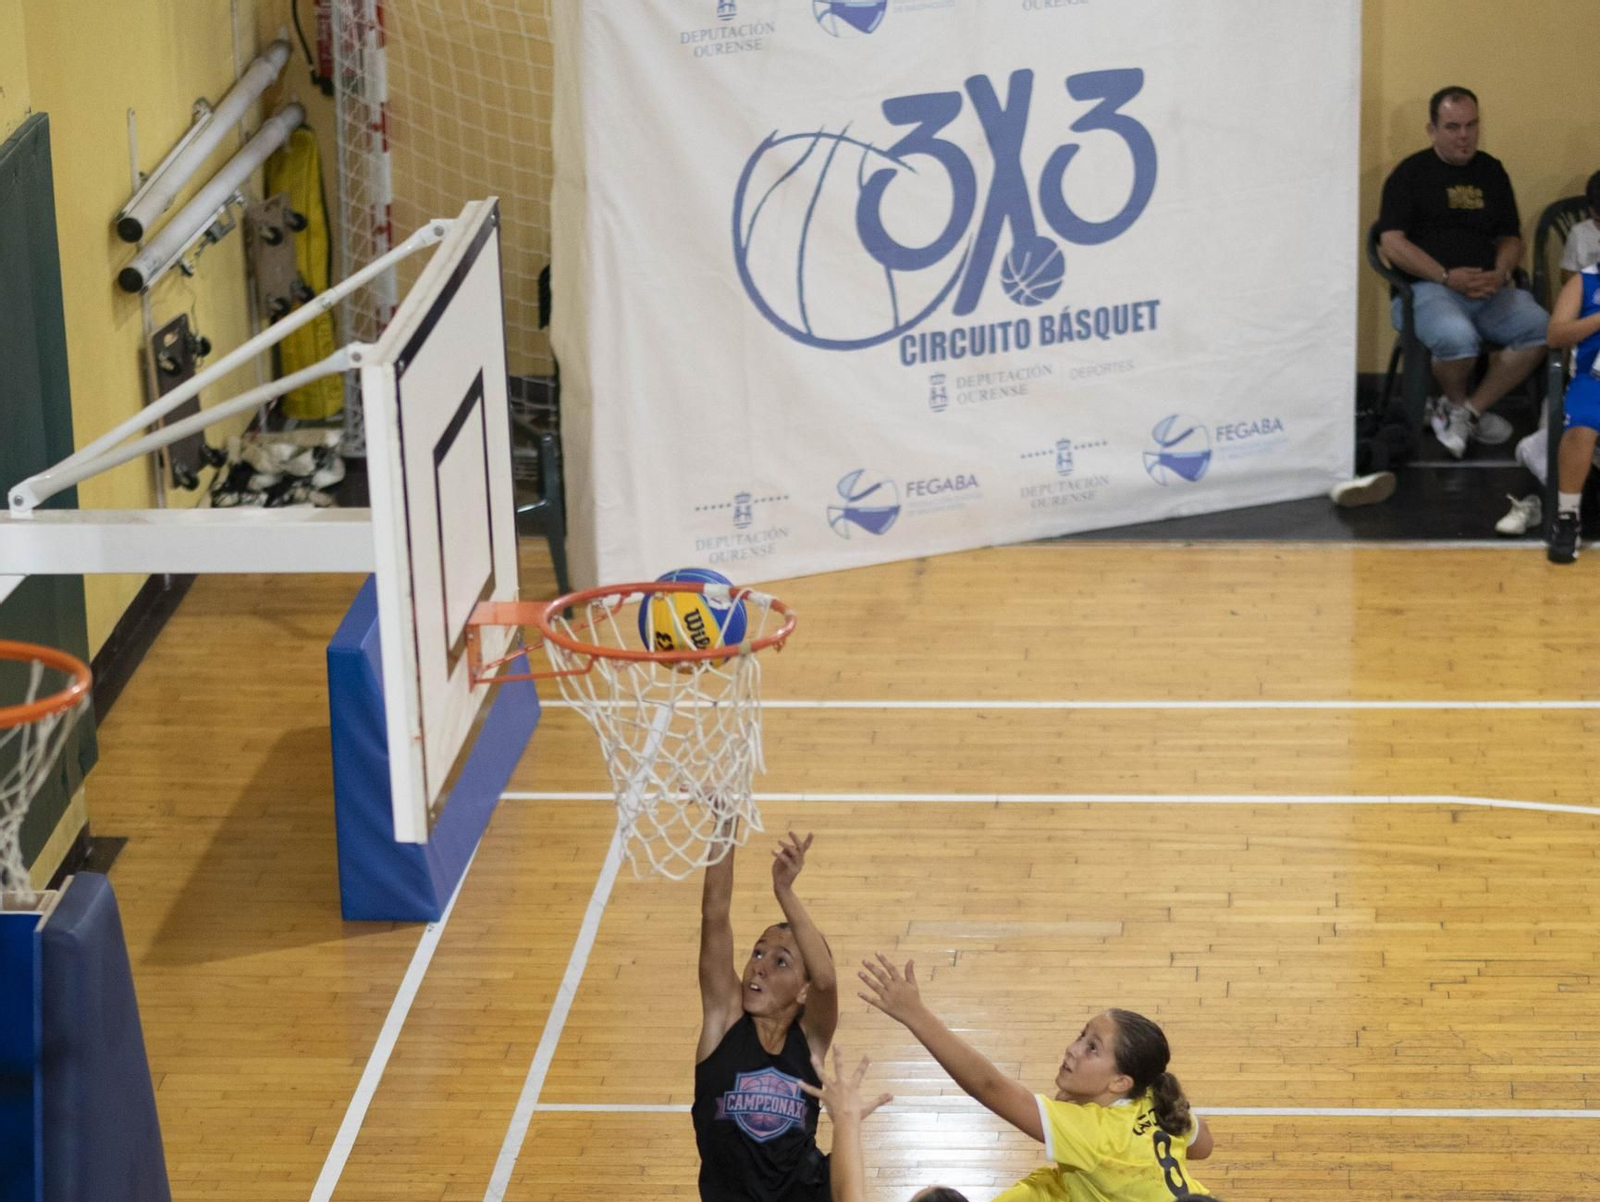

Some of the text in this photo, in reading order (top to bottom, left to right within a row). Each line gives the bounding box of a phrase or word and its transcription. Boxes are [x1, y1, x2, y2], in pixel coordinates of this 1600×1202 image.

[681, 19, 776, 44] DEPUTACIÓN
[694, 39, 762, 57] OURENSE
[901, 299, 1160, 366] CIRCUITO BÁSQUET
[956, 363, 1053, 389] DEPUTACIÓN
[957, 384, 1028, 405] OURENSE
[1216, 416, 1284, 443] FEGABA
[906, 474, 979, 498] FEGABA
[709, 543, 776, 564] OURENSE
